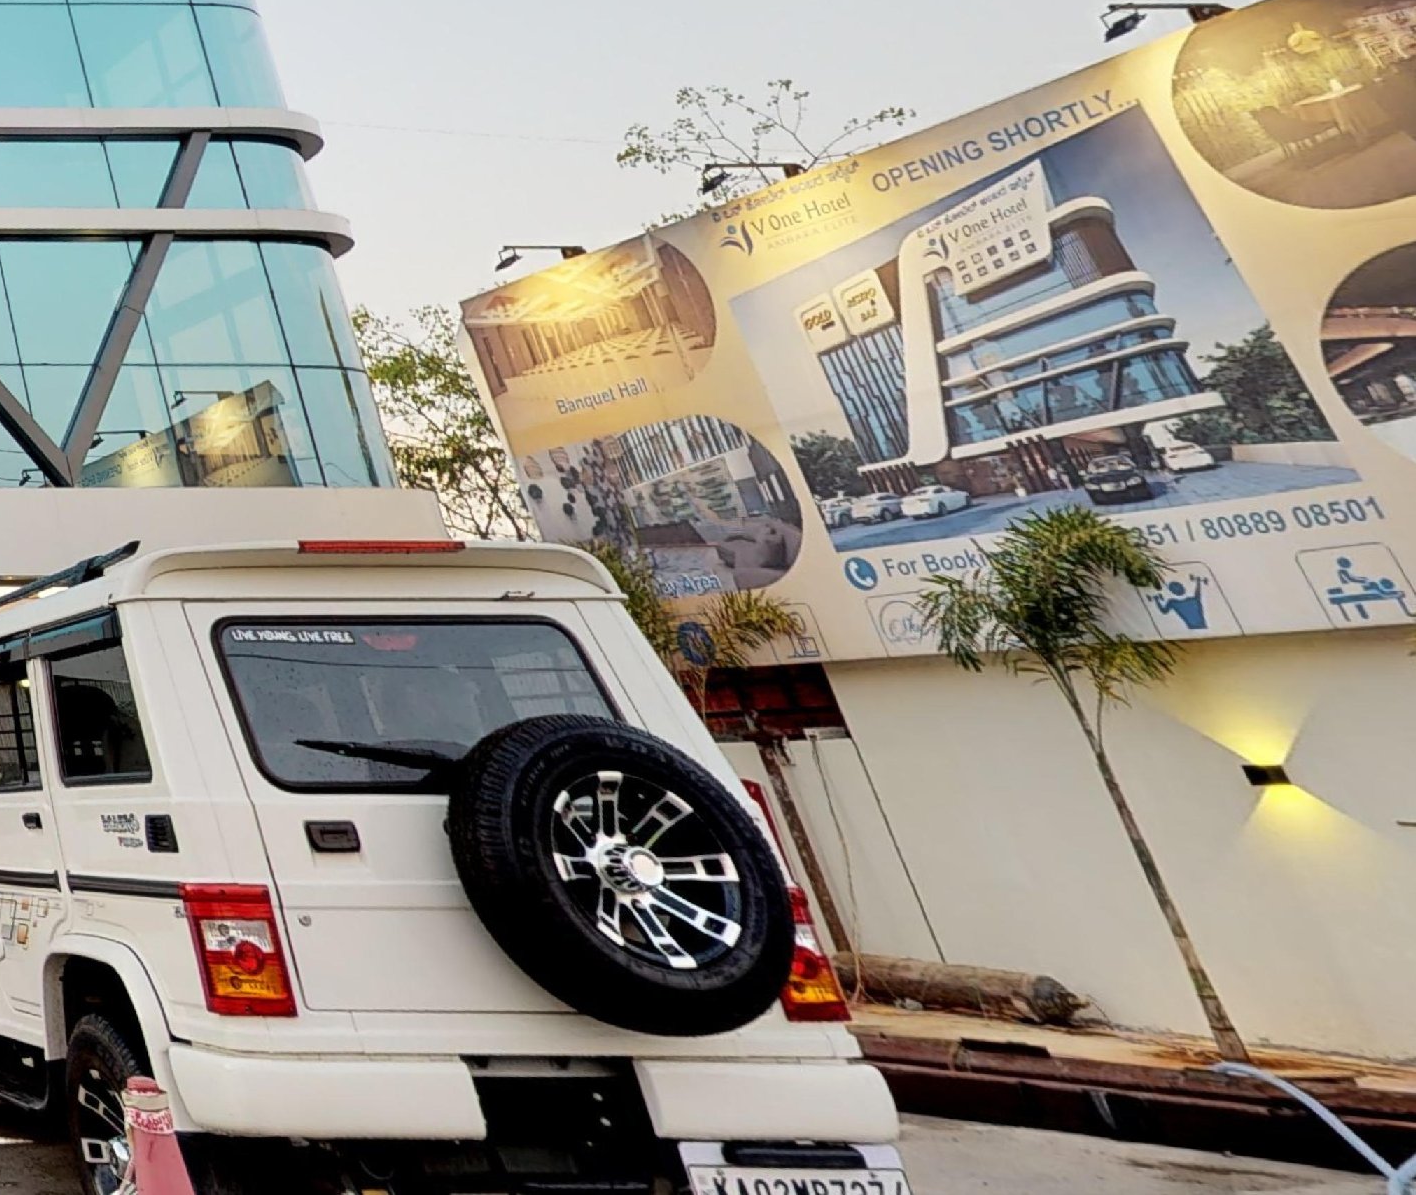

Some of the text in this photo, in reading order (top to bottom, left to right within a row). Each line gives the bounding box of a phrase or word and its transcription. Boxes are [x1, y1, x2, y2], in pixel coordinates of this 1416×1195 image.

[871, 140, 985, 192] OPENING
[749, 192, 852, 236] V One Hotel
[555, 377, 648, 415] Banquet Hall
[882, 559, 918, 577] For
[1131, 522, 1180, 548] 351
[1200, 510, 1287, 541] 80889
[1292, 496, 1386, 529] 08501
